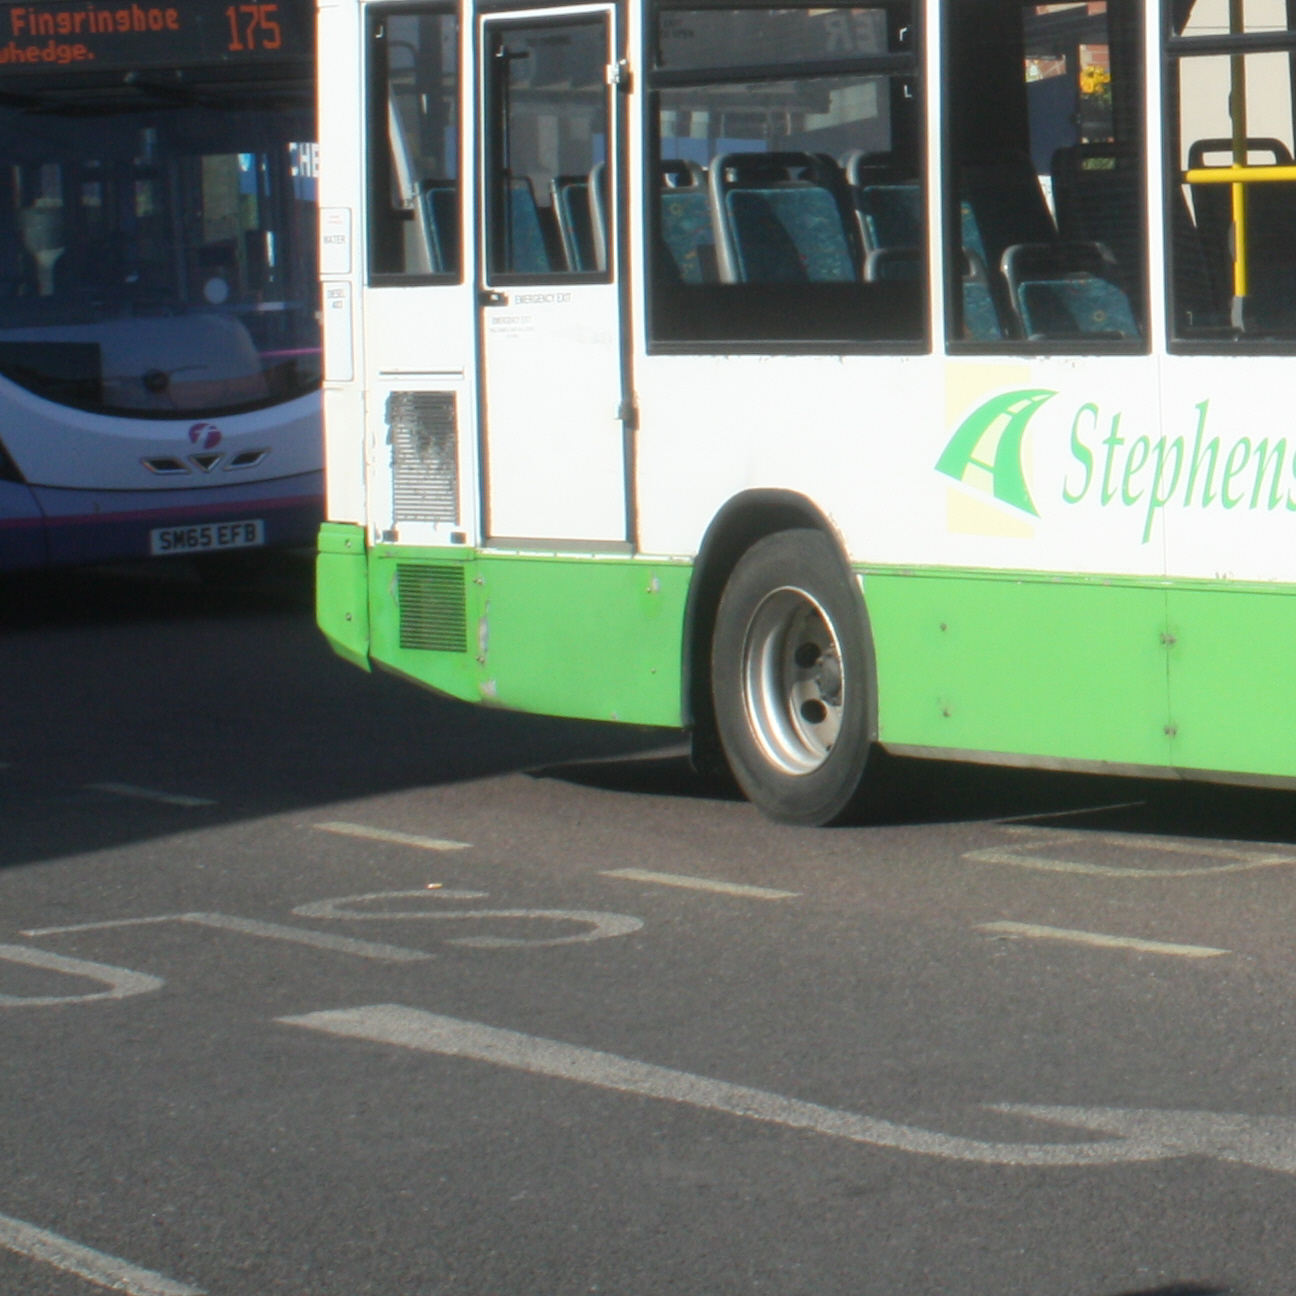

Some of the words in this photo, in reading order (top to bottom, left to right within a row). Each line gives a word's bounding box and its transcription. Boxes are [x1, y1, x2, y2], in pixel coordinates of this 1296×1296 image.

[10, 3, 180, 37] Fingringhoe
[224, 4, 282, 51] 175
[324, 234, 346, 244] WATER
[514, 293, 555, 305] EMERGENCY
[557, 292, 571, 303] EXIT
[160, 527, 213, 550] SM65
[218, 523, 256, 545] EFB
